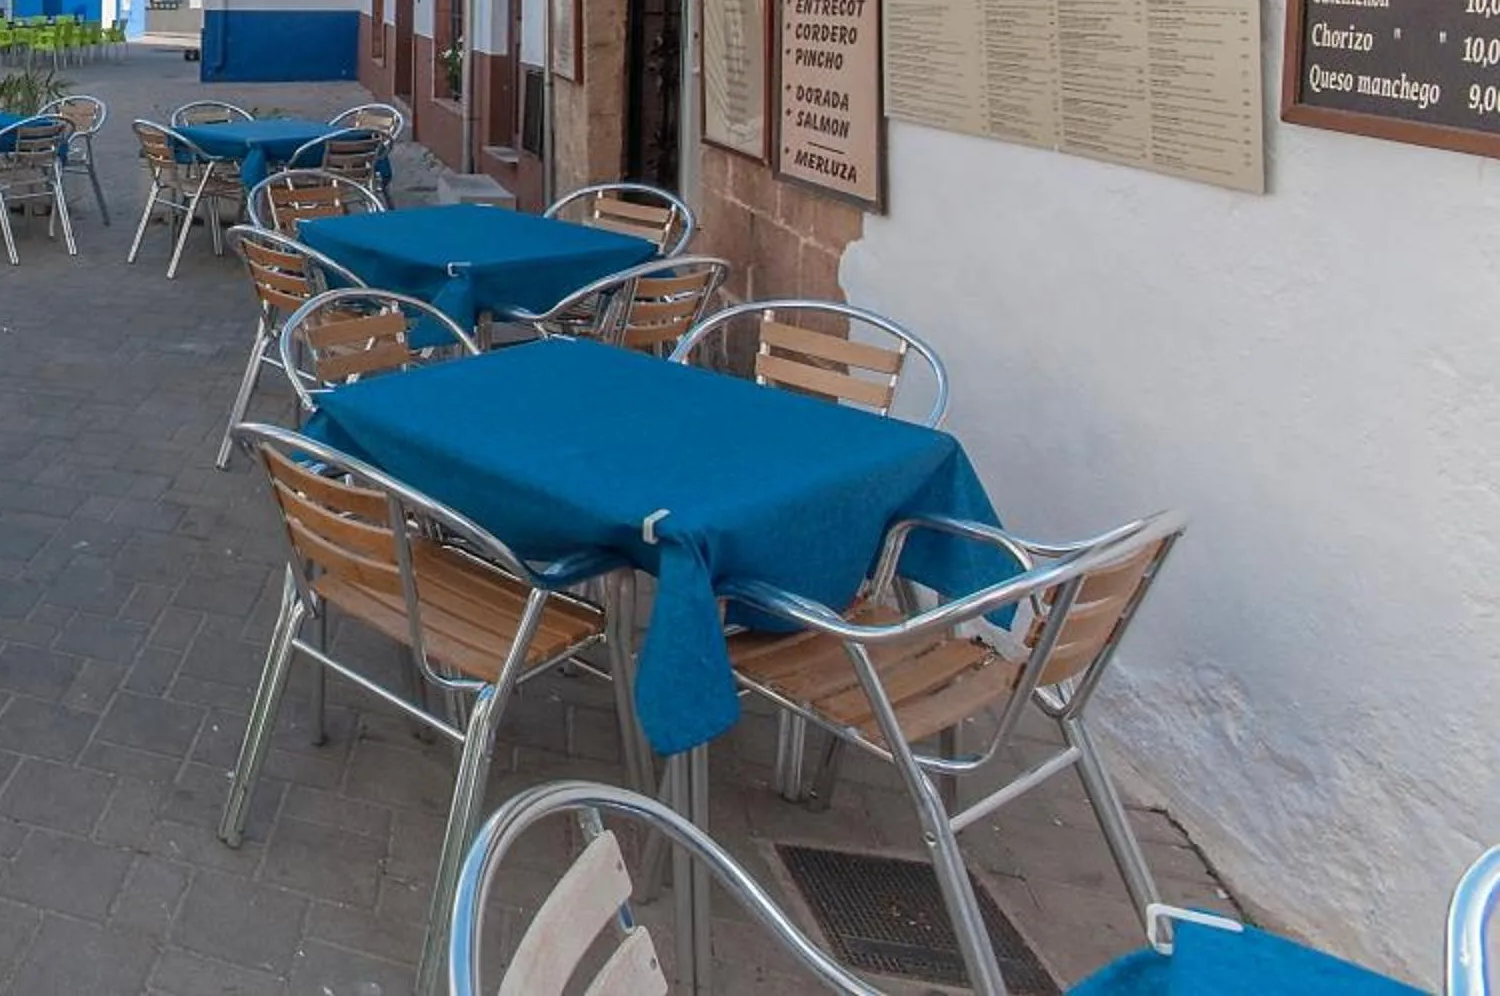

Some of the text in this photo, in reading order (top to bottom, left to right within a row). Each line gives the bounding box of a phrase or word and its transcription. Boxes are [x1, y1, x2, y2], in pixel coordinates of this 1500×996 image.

[795, 24, 857, 45] CORDERO
[1311, 22, 1373, 51] Chorizo
[795, 49, 843, 70] PINCHO
[796, 84, 849, 111] DORADA
[1309, 64, 1353, 93] Queso
[1357, 73, 1441, 109] manchego
[796, 111, 850, 138] SALMON
[794, 150, 857, 183] MERLUZA
